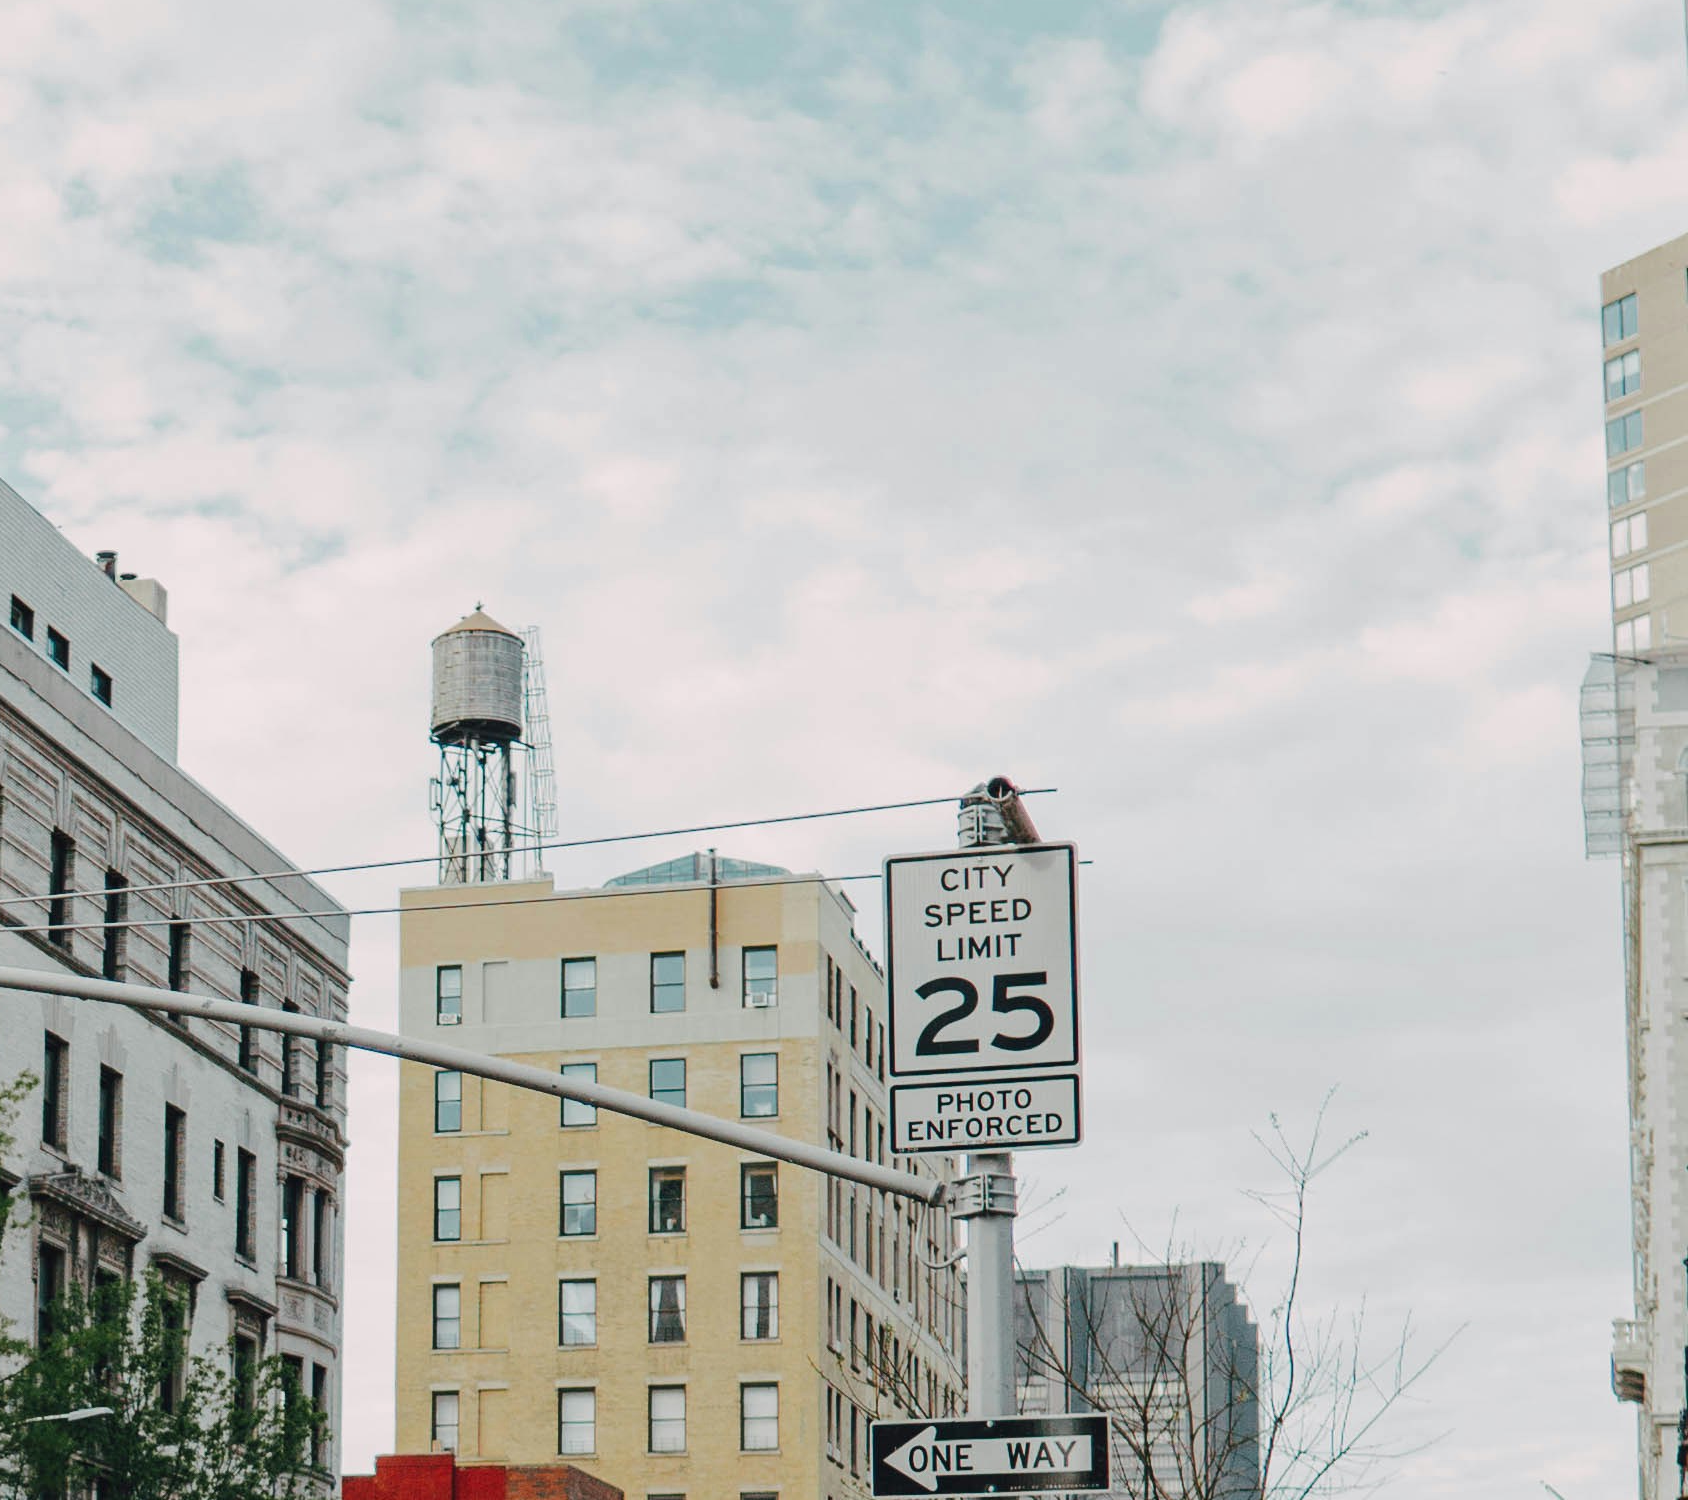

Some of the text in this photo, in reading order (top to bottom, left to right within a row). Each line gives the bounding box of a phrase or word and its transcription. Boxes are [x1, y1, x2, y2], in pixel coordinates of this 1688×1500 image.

[940, 863, 1015, 892] CITY
[923, 897, 1033, 928] SPEED
[936, 932, 1023, 962] LIMIT
[914, 970, 1056, 1057] 25
[936, 1088, 1033, 1115] PHOTO
[907, 1112, 1064, 1142] ENFORCED
[908, 1440, 1077, 1473] ONE WAY
